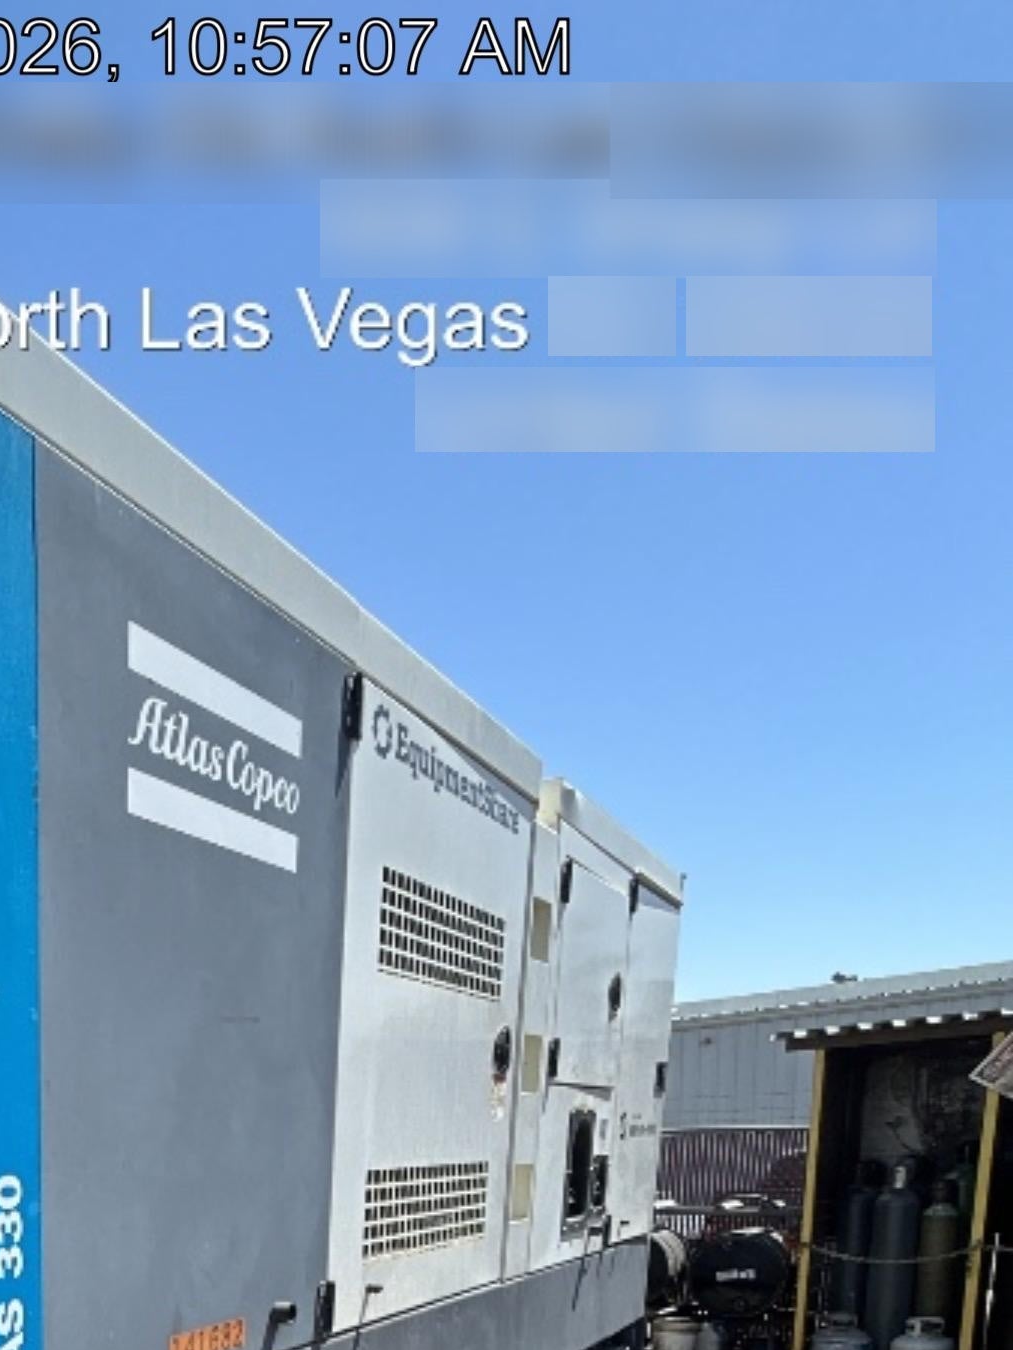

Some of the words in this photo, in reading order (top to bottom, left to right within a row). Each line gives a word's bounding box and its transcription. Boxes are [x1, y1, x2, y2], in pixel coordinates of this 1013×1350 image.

[128, 696, 224, 781] Atlas
[227, 740, 300, 814] Copco
[395, 723, 520, 834] EquipmentShare
